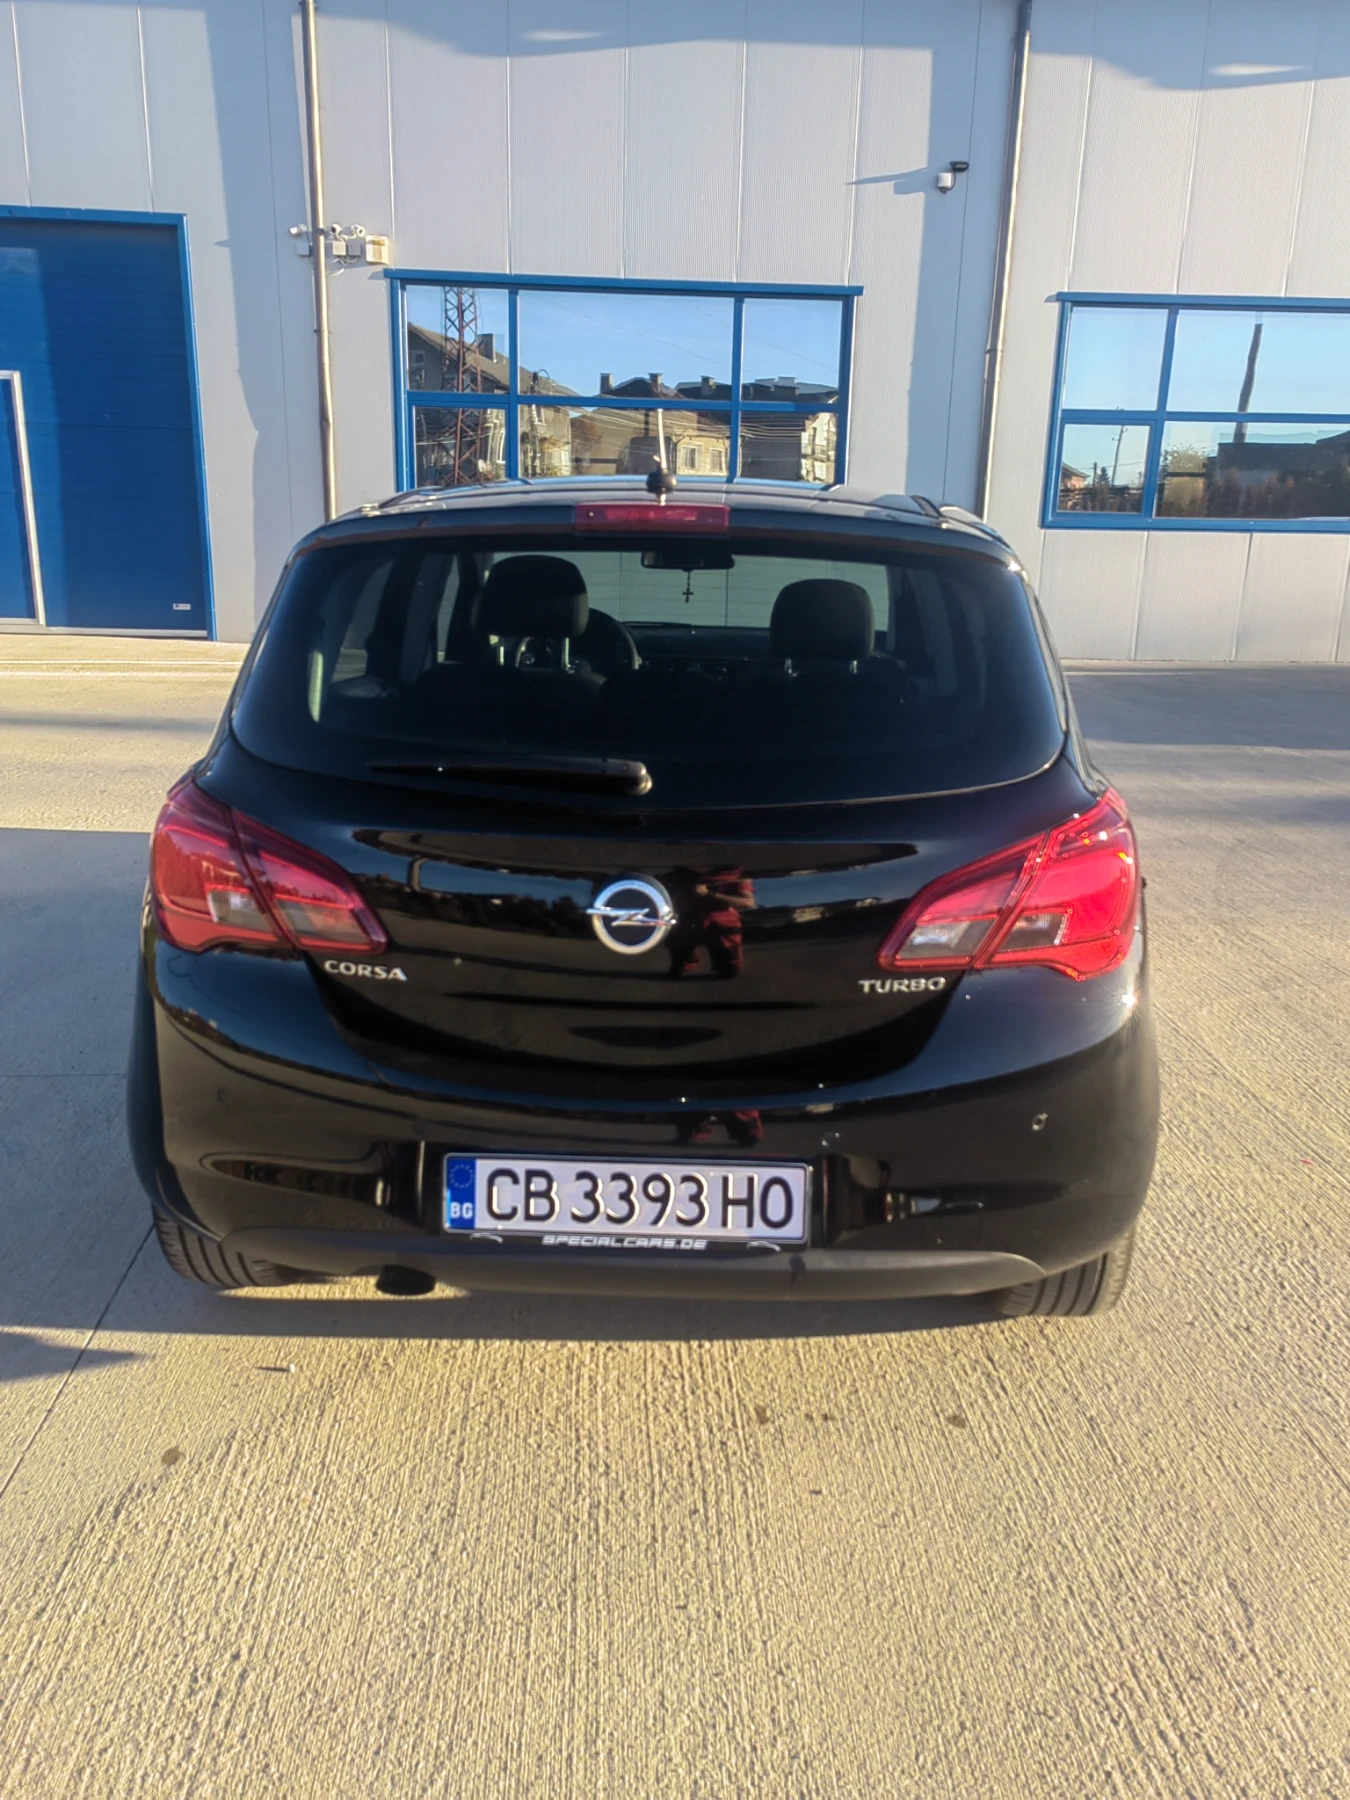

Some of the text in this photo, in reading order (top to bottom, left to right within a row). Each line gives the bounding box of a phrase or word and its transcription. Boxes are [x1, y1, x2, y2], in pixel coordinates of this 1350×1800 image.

[324, 960, 408, 981] CORSA
[858, 977, 946, 994] TURBO
[486, 1167, 794, 1230] CB 3393 HO
[450, 1202, 473, 1219] BG
[541, 1234, 708, 1250] SPECIALCARS.DE
